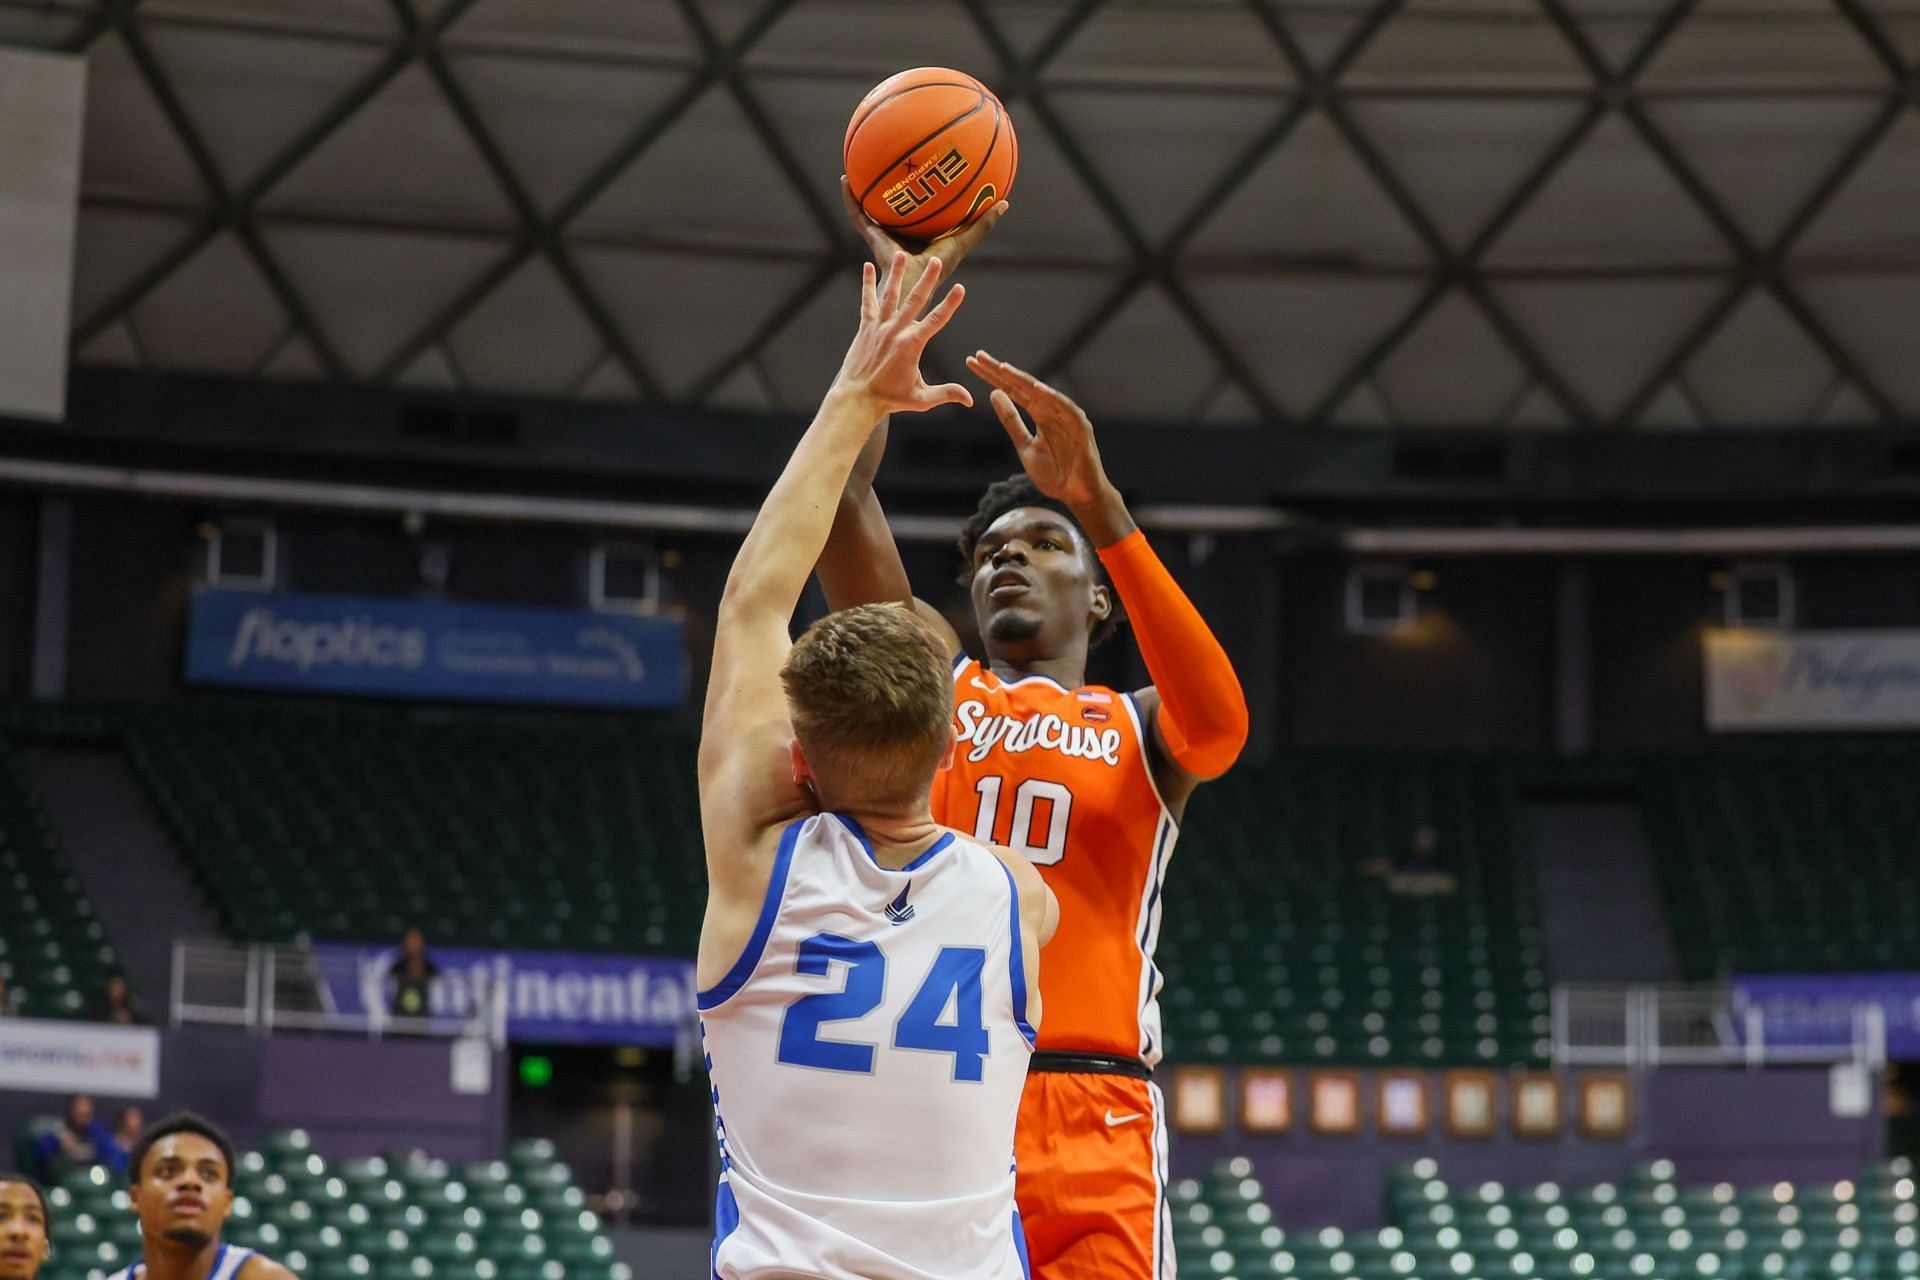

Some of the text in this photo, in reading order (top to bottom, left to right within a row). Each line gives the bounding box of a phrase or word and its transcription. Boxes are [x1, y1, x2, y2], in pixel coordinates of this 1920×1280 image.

[885, 148, 970, 218] ELITE
[955, 699, 1122, 767] Syracuse
[974, 775, 1074, 866] 10
[358, 948, 697, 1026] Cntinental
[776, 931, 991, 1085] 24
